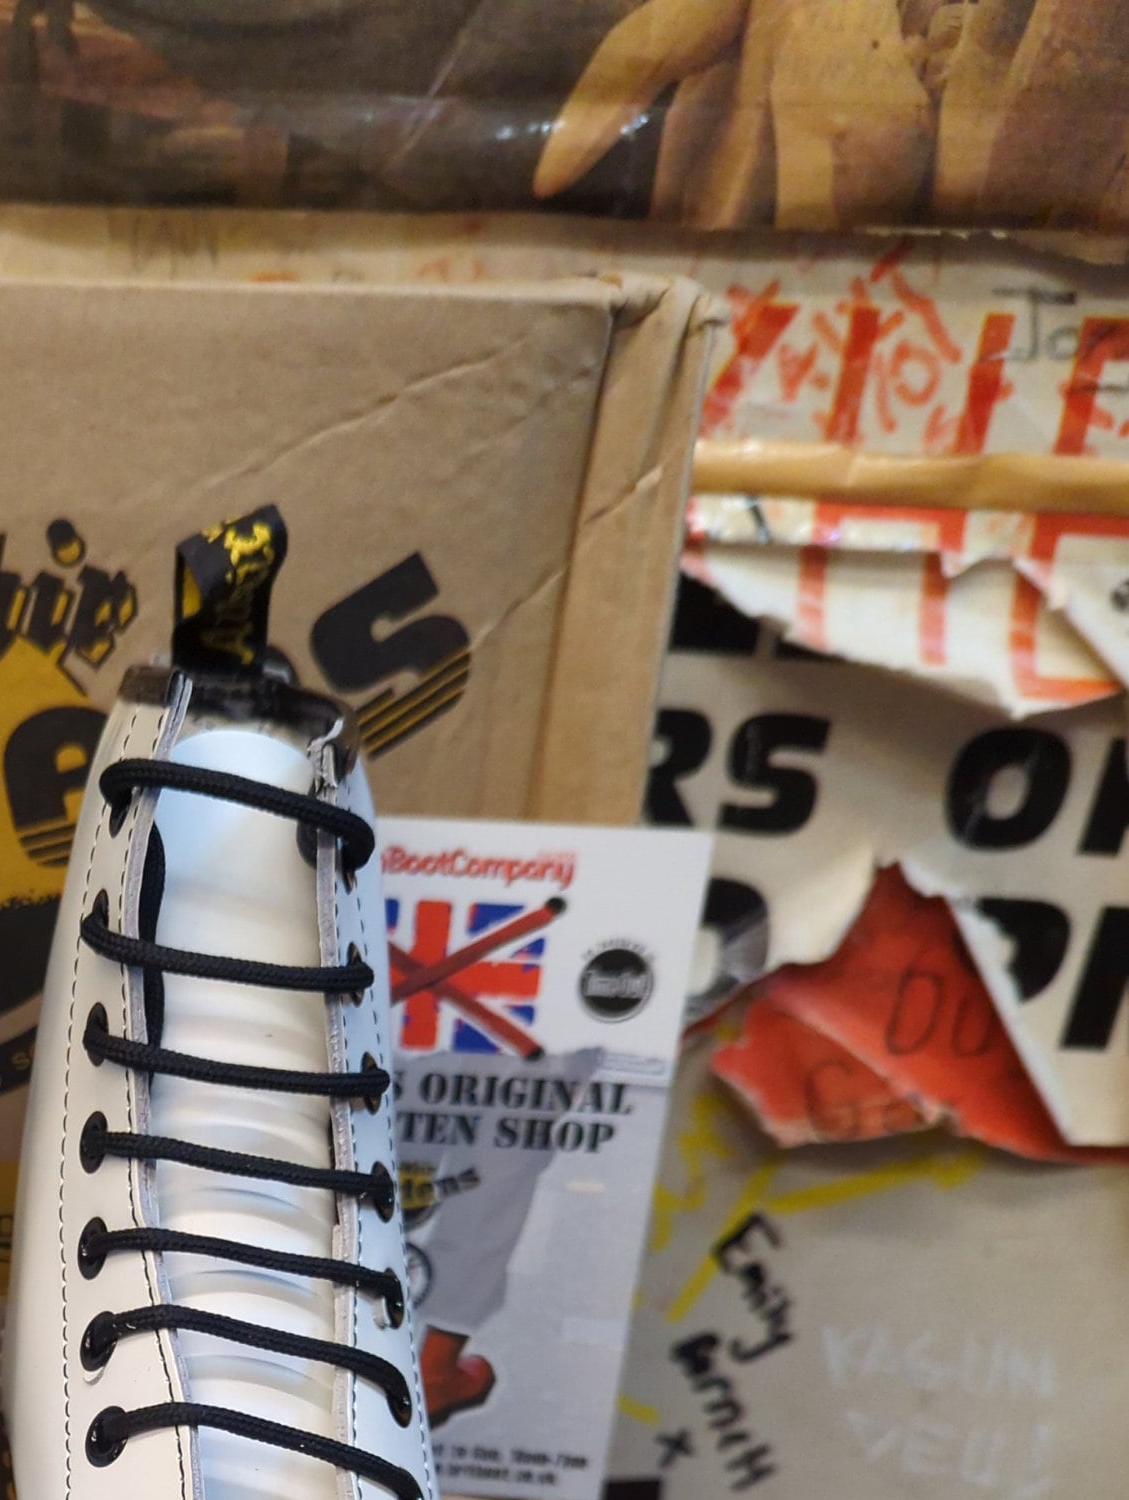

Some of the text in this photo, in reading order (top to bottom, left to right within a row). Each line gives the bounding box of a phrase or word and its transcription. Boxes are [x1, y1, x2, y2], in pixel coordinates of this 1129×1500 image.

[420, 1072, 633, 1116] ORIGINAL
[398, 1112, 615, 1154] TEN SHOP
